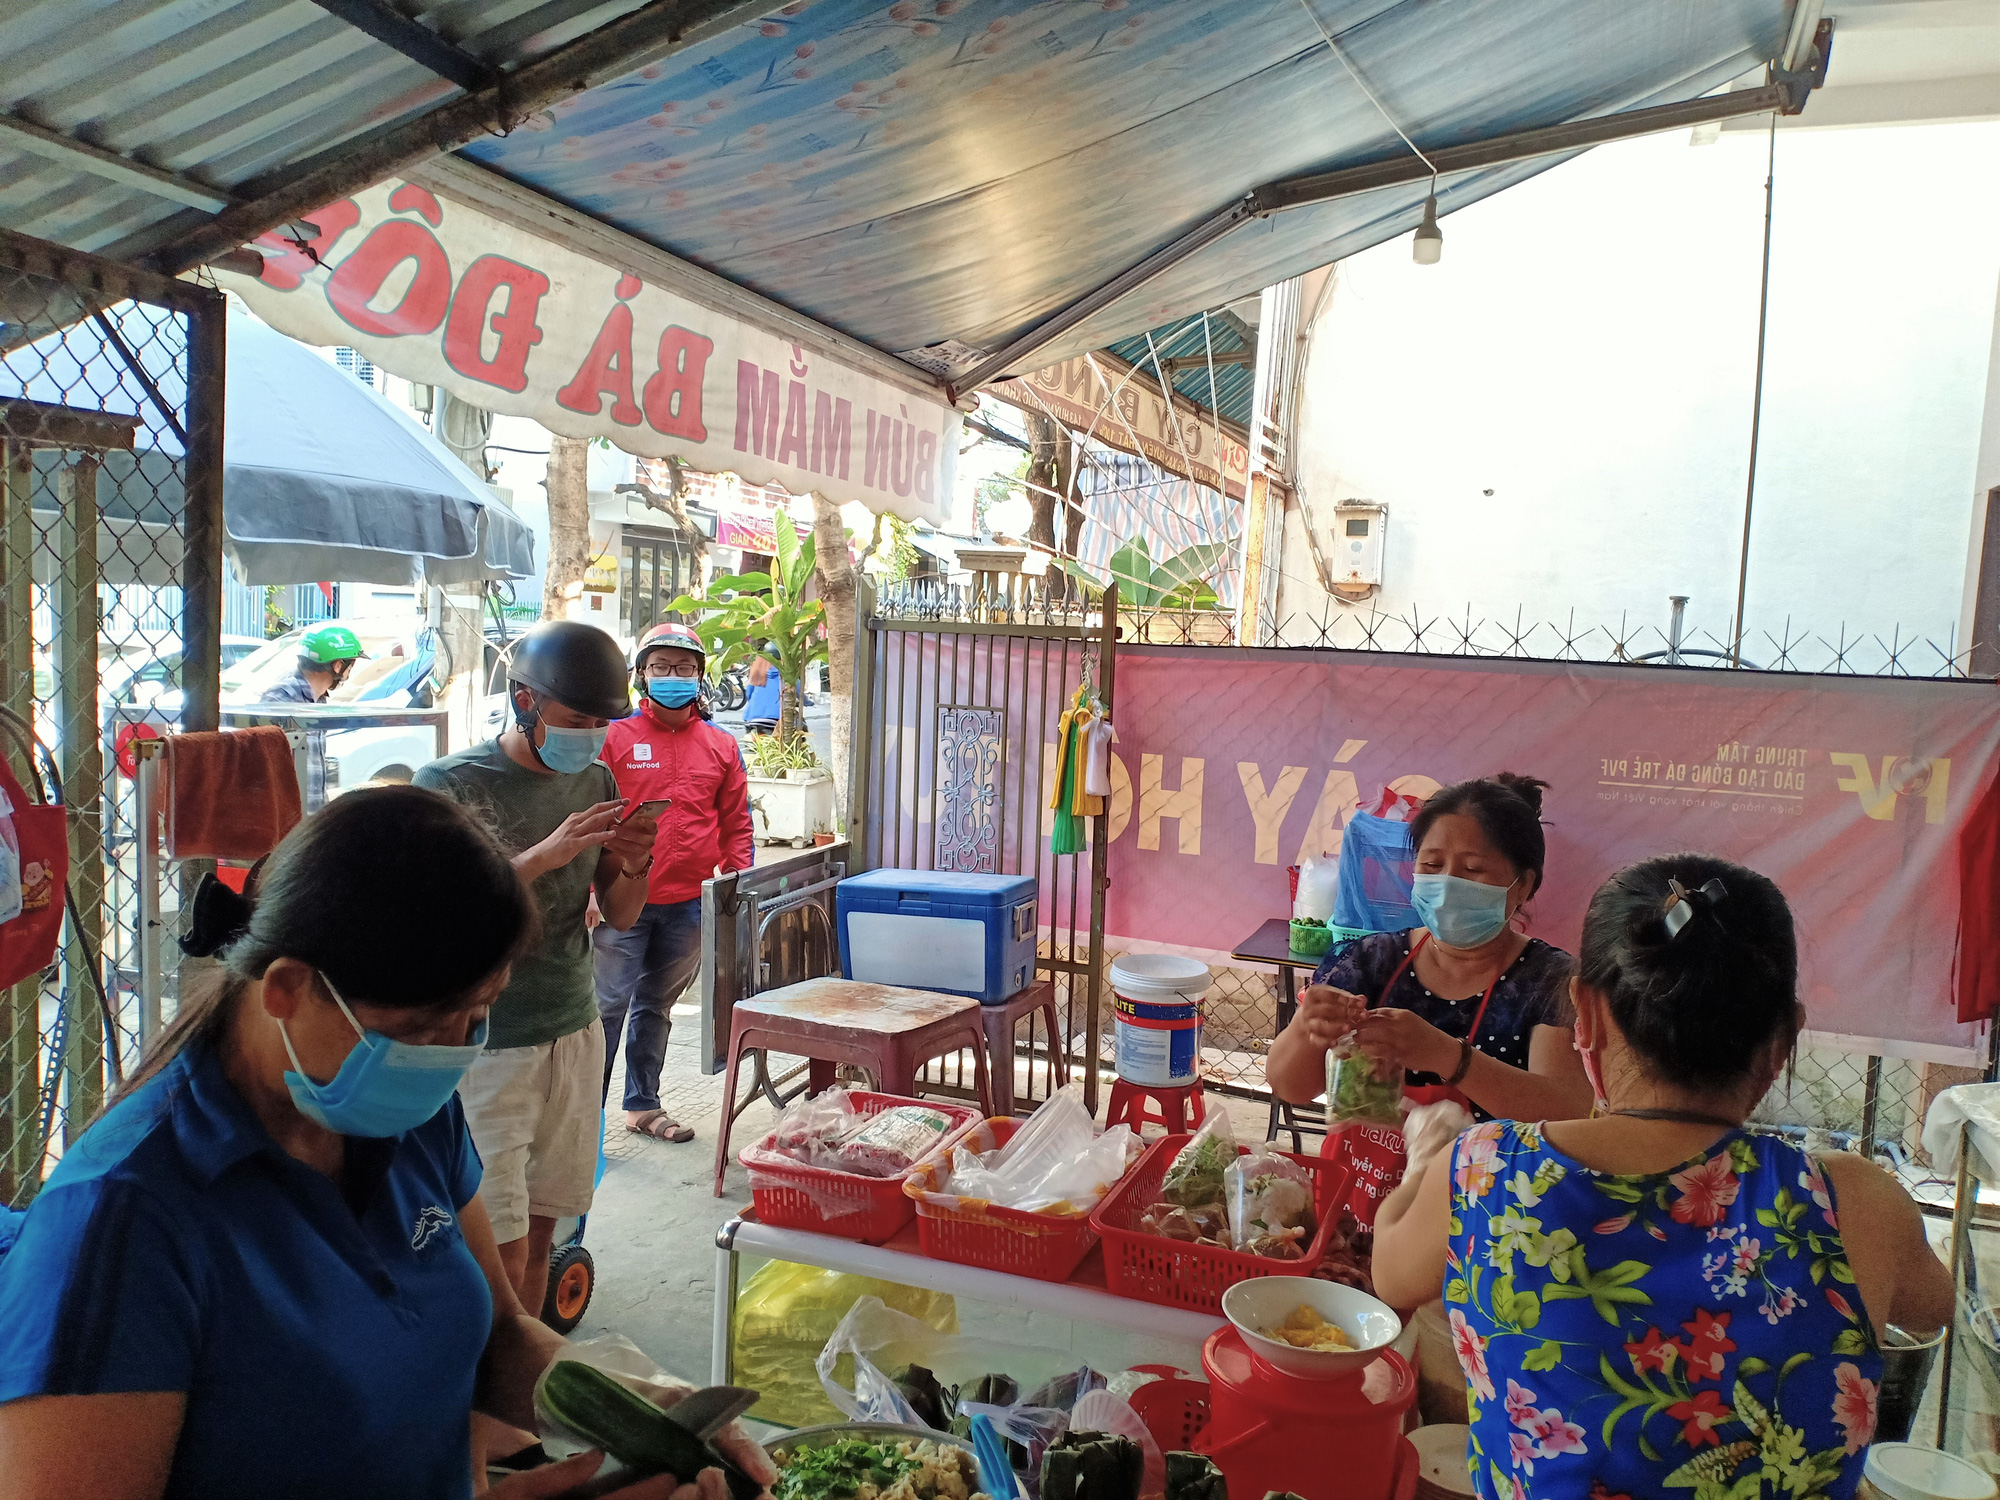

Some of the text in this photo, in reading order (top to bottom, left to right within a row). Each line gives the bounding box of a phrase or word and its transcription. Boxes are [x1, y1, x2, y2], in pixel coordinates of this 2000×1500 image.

[626, 761, 661, 770] NowFood
[1114, 996, 1136, 1015] LITE
[1351, 1156, 1374, 1175] uyết
[1364, 1182, 1398, 1199] ngườ
